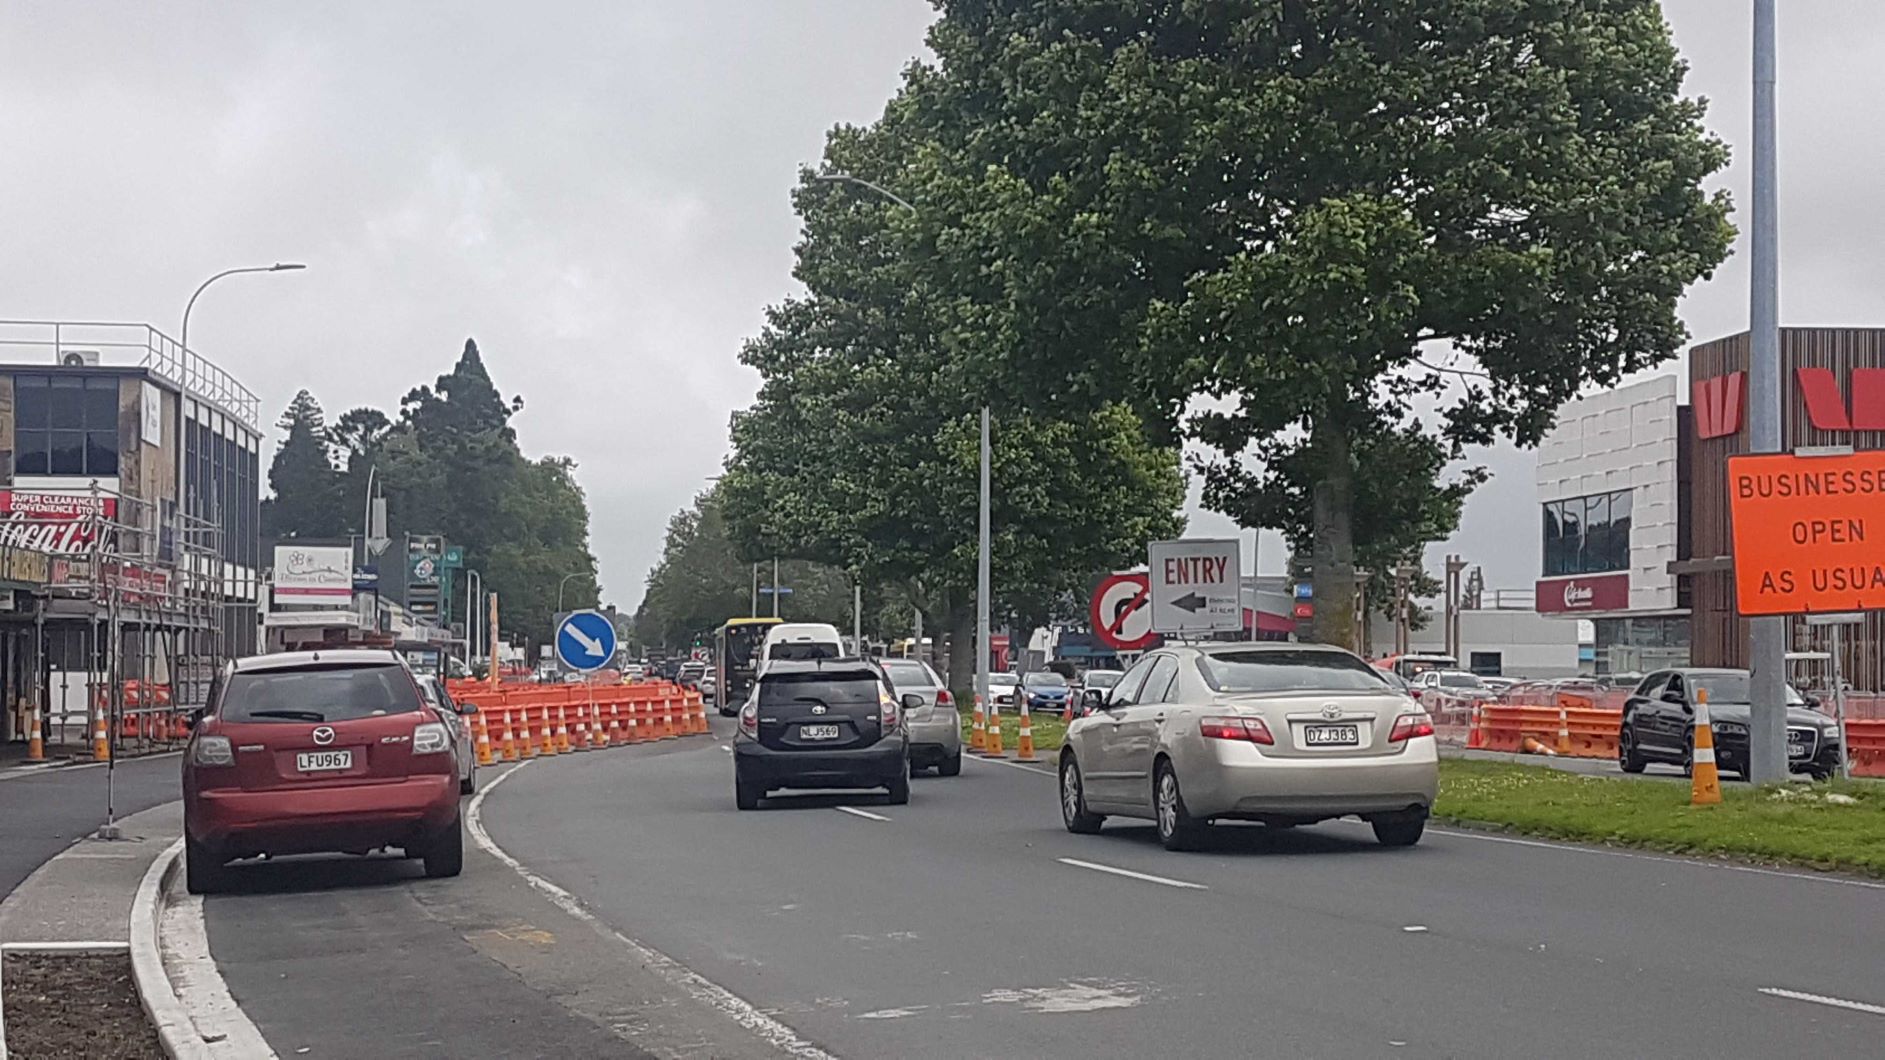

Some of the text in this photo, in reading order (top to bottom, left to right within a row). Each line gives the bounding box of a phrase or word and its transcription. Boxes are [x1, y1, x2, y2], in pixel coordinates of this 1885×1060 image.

[11, 493, 41, 502] SUPER
[10, 502, 105, 516] CONVENIENCE STOE
[1792, 519, 1865, 545] OPEN
[1164, 556, 1228, 585] ENTRY
[1759, 570, 1795, 594] AS
[1308, 728, 1356, 741] DZJ383
[299, 753, 349, 768] LFU967
